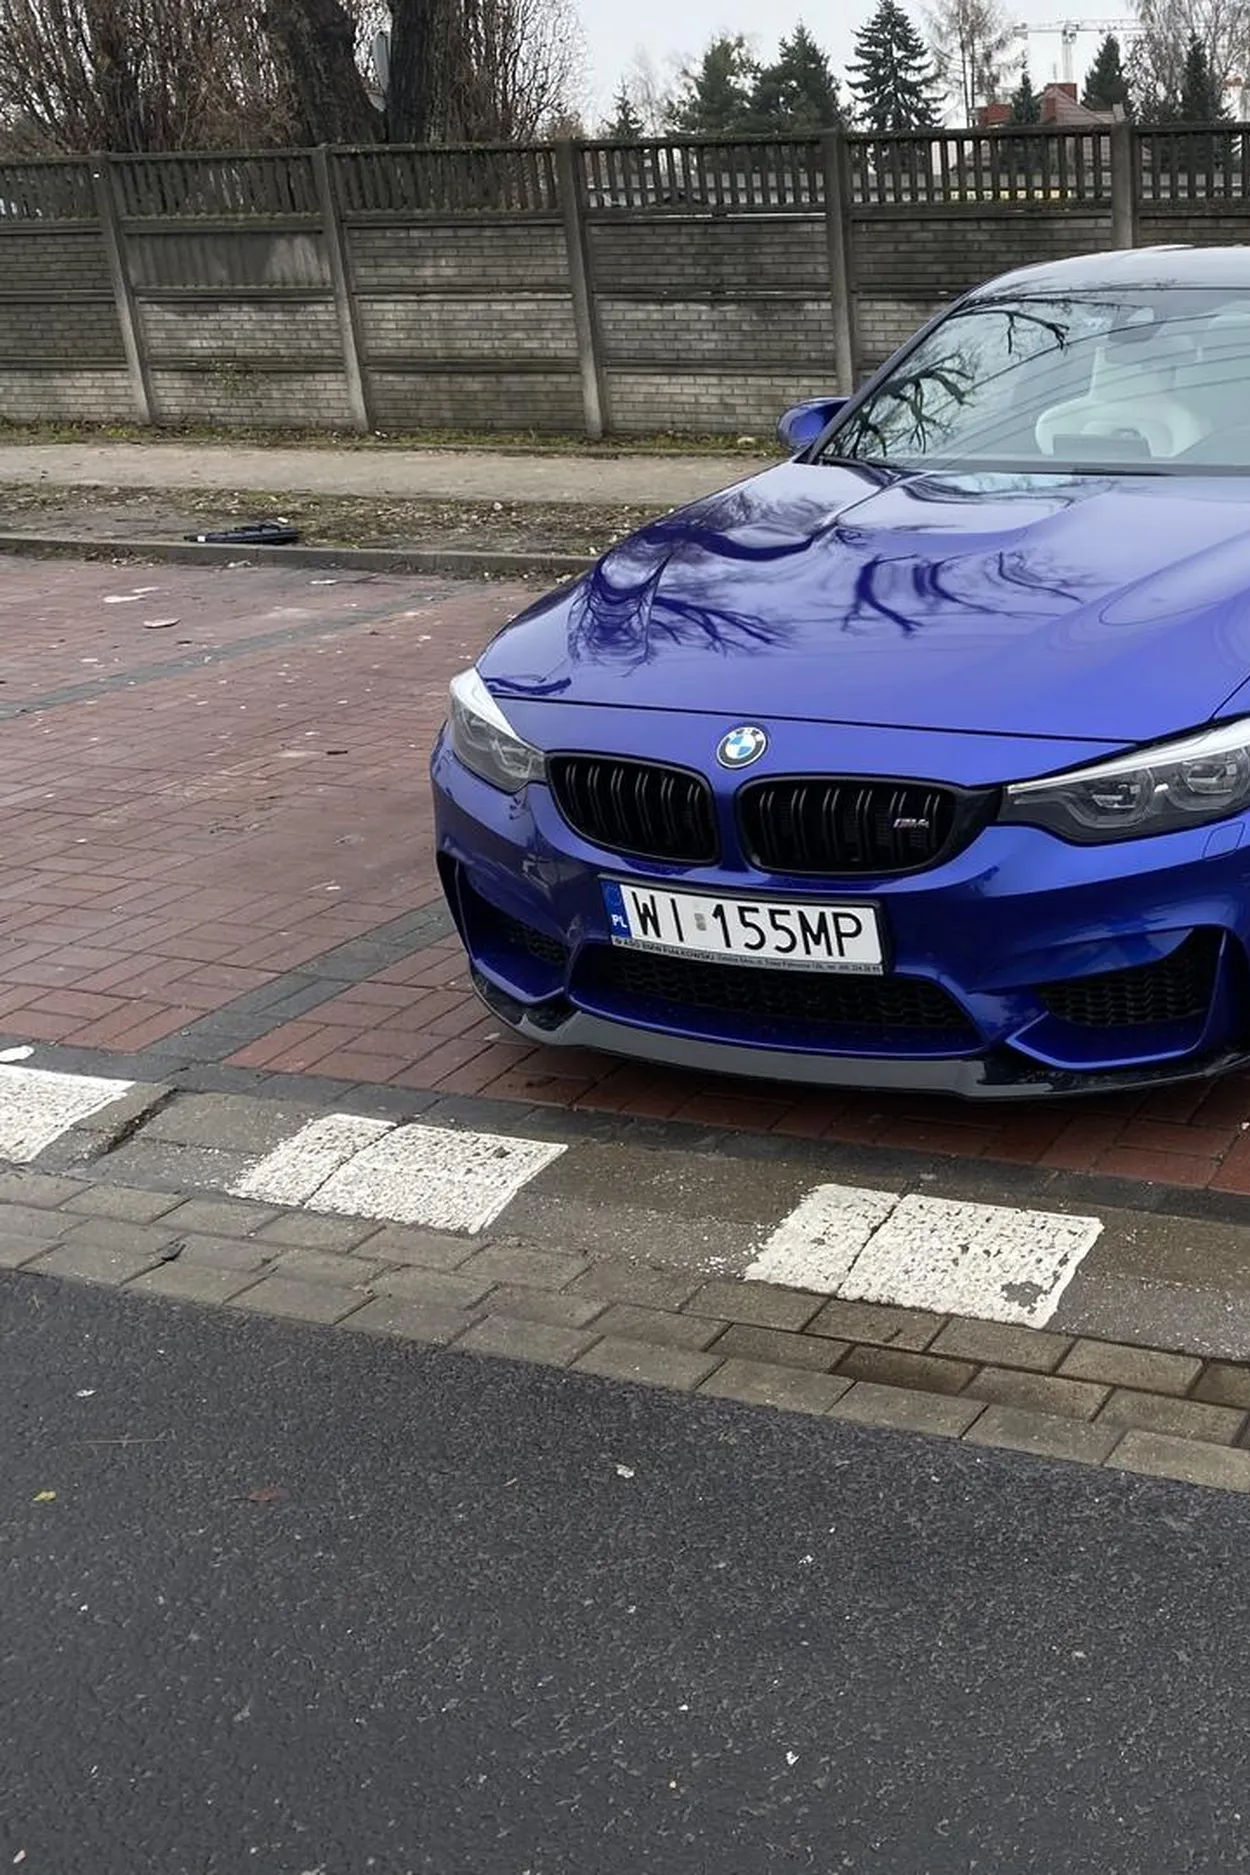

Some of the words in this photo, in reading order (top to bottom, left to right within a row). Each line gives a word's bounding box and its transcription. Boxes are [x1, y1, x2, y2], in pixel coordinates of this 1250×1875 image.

[611, 913, 628, 929] PL
[630, 890, 686, 943] WI
[711, 902, 863, 958] 155MP
